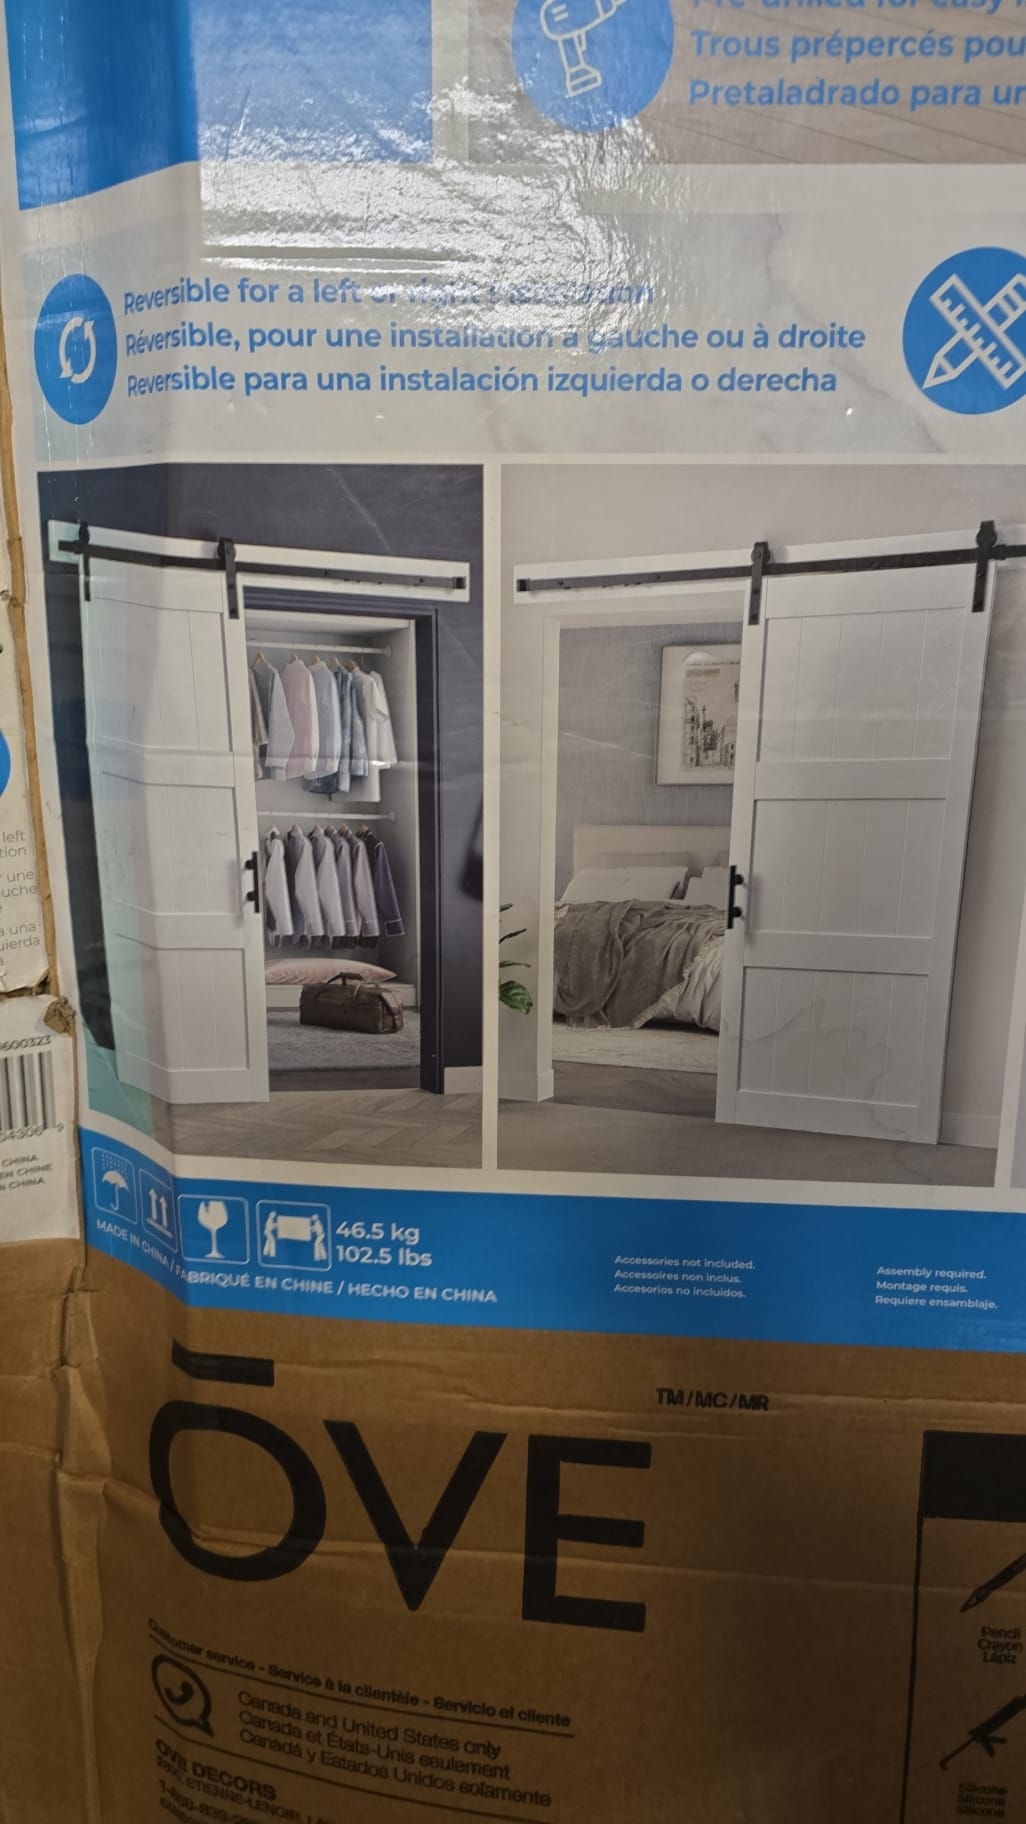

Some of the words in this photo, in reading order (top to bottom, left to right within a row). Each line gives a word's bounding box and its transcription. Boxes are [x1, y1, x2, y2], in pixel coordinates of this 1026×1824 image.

[690, 29, 781, 58] Trous
[791, 28, 954, 64] prépercés
[689, 78, 900, 107] Pretaladrado
[910, 83, 981, 112] para
[124, 277, 231, 315] Reversible
[237, 278, 280, 303] for
[287, 284, 304, 303] a
[313, 277, 362, 304] left
[125, 320, 240, 357] Réversible,
[248, 327, 317, 353] pour
[325, 327, 382, 347] une
[588, 324, 698, 354] gauche
[706, 329, 745, 348] ou
[752, 323, 770, 348] à
[777, 322, 866, 349] droite
[127, 364, 236, 397] Reversible
[244, 371, 308, 396] para
[317, 371, 371, 391] una
[380, 364, 539, 392] instalación
[547, 365, 683, 398] izquierda
[690, 374, 711, 392] o
[717, 367, 837, 392] derecha
[2, 830, 26, 844] left
[6, 870, 34, 883] une
[9, 923, 36, 935] una
[335, 1221, 385, 1240] 46.5
[390, 1222, 420, 1246] kg
[96, 1218, 130, 1242] MADE
[129, 1231, 141, 1247] IN
[141, 1240, 170, 1268] CHINA
[175, 1265, 251, 1289] FABRIQUÉ
[254, 1276, 277, 1290] EN
[281, 1277, 334, 1295] CHINE
[348, 1282, 410, 1299] HECHO
[413, 1286, 438, 1300] EN
[440, 1287, 498, 1304] CHINA
[335, 1245, 393, 1265] 102.5
[398, 1248, 433, 1267] lbs
[614, 1255, 680, 1266] Accessories
[682, 1259, 701, 1268] not
[704, 1258, 756, 1270] included.
[614, 1269, 679, 1281] Accessoires
[681, 1273, 703, 1282] non
[706, 1273, 742, 1284] inclus.
[876, 1266, 932, 1279] Assembly
[934, 1269, 987, 1280] required.
[614, 1283, 673, 1295] Accesorios
[675, 1287, 690, 1296] no
[693, 1286, 747, 1299] incluidos.
[876, 1281, 927, 1293] Montage
[929, 1285, 969, 1294] requis.
[875, 1295, 926, 1307] Requiere
[928, 1299, 998, 1311] ensamblaje.
[656, 1387, 770, 1412] TM/MC/MR
[148, 1617, 205, 1657] Customer
[206, 1651, 256, 1671] service
[268, 1664, 322, 1688] Service
[338, 1679, 352, 1695] la
[433, 1696, 497, 1717] Servicio
[517, 1710, 571, 1728] cliente
[238, 1690, 301, 1720] Canada
[305, 1707, 338, 1728] and
[342, 1717, 399, 1741] United
[402, 1727, 459, 1752] States
[463, 1741, 502, 1760] only
[238, 1710, 302, 1739] Canada
[305, 1730, 323, 1744] et
[239, 1729, 303, 1759] Canadá
[306, 1752, 317, 1764] y
[321, 1752, 390, 1780] Estados
[393, 1768, 456, 1793] Unidos
[191, 1761, 277, 1801] DECORS
